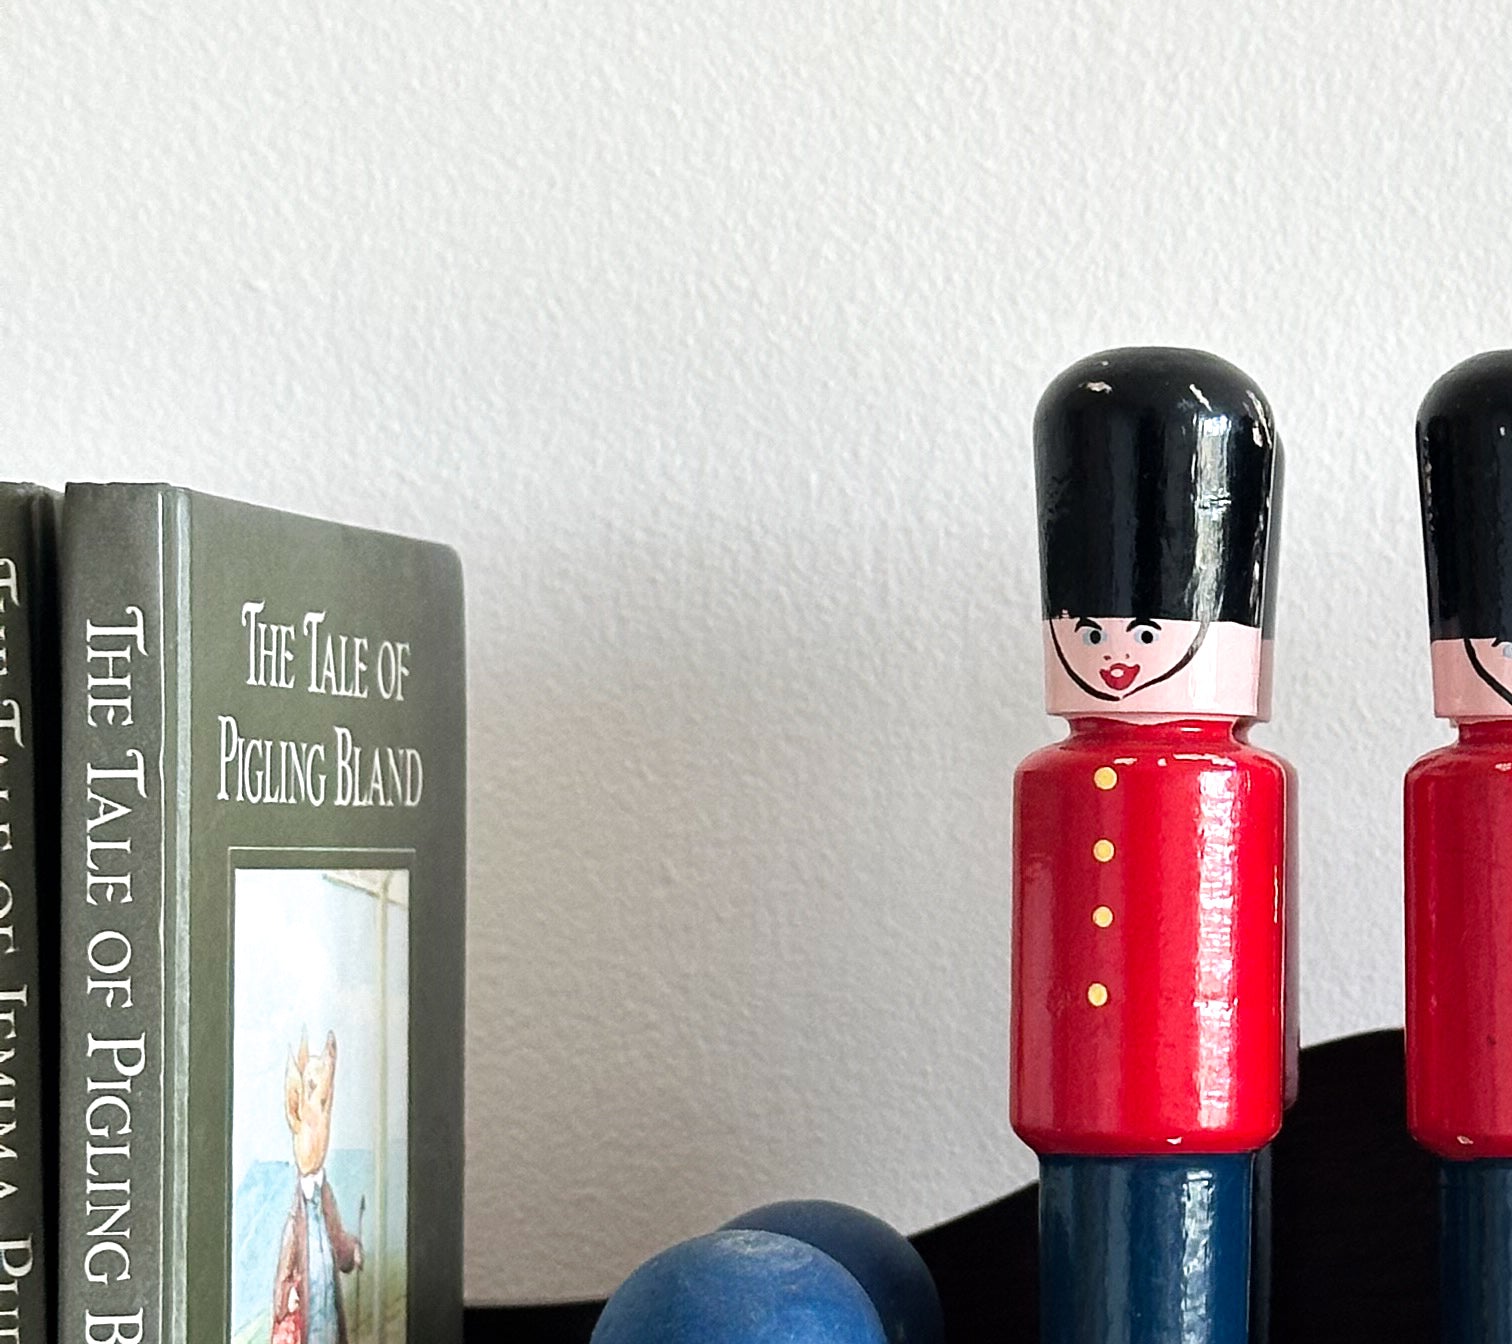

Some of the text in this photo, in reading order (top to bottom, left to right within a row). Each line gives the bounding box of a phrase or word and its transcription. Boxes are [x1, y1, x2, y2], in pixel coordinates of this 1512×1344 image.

[86, 606, 148, 728] THE
[241, 599, 411, 701] THE TALE OF
[216, 714, 423, 807] PIGLING BLAND
[86, 748, 148, 907] TALE
[87, 929, 133, 1009] OF
[84, 1032, 147, 1286] PIGLING
